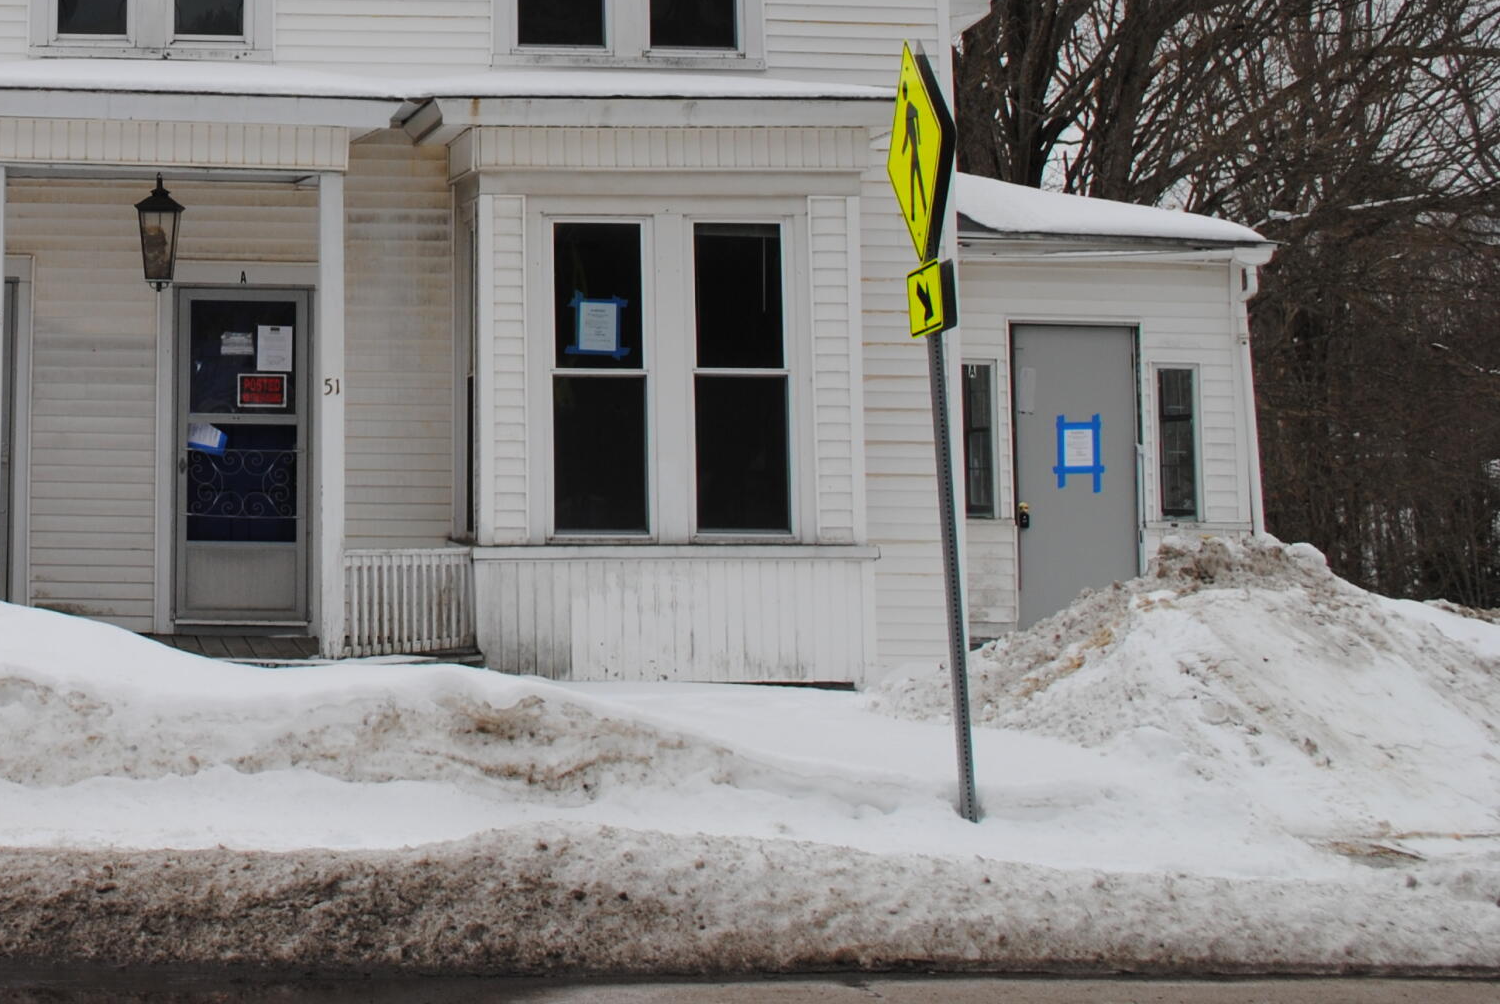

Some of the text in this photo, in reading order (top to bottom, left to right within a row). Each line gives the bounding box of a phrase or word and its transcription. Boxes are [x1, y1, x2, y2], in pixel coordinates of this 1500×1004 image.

[240, 270, 247, 285] A
[243, 377, 281, 392] POSTED
[324, 378, 340, 396] 51
